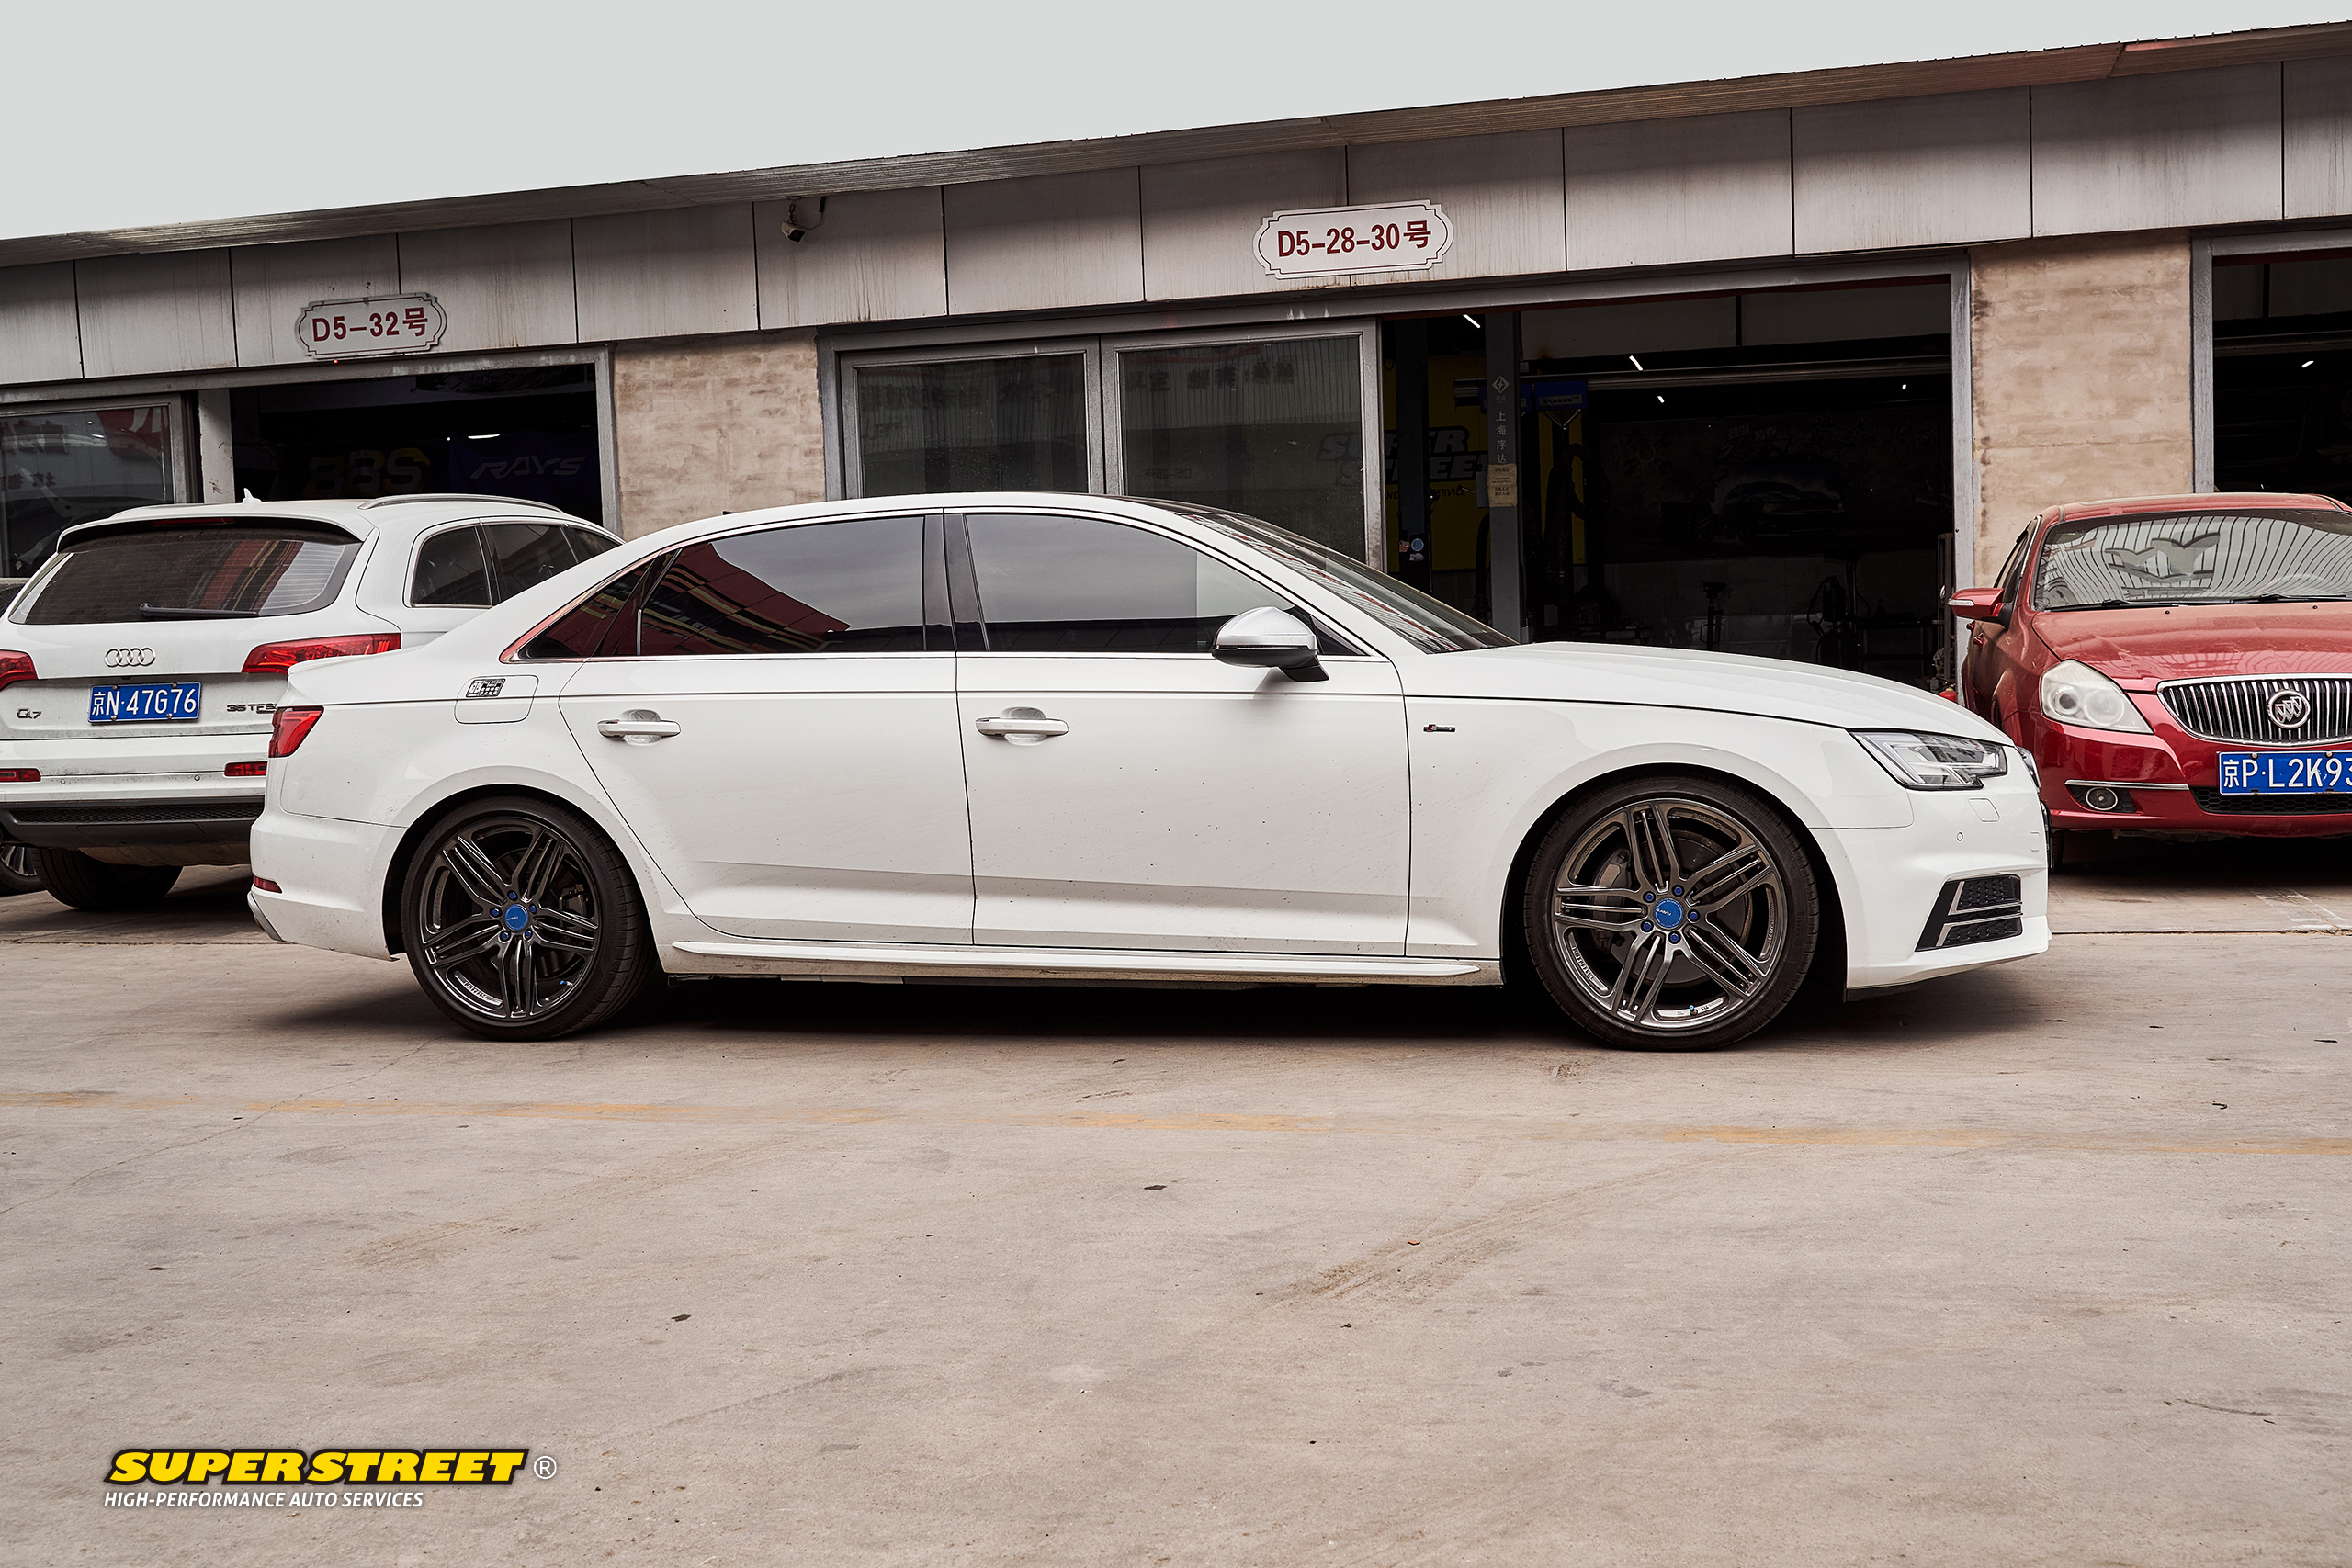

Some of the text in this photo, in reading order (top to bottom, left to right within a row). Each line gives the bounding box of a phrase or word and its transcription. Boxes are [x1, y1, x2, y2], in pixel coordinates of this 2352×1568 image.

[1277, 220, 1431, 257] D5-28-30号
[312, 307, 428, 342] D5-32号
[302, 447, 430, 497] BBS
[469, 455, 586, 479] RAYS
[17, 708, 42, 719] Q7
[227, 704, 247, 713] 35
